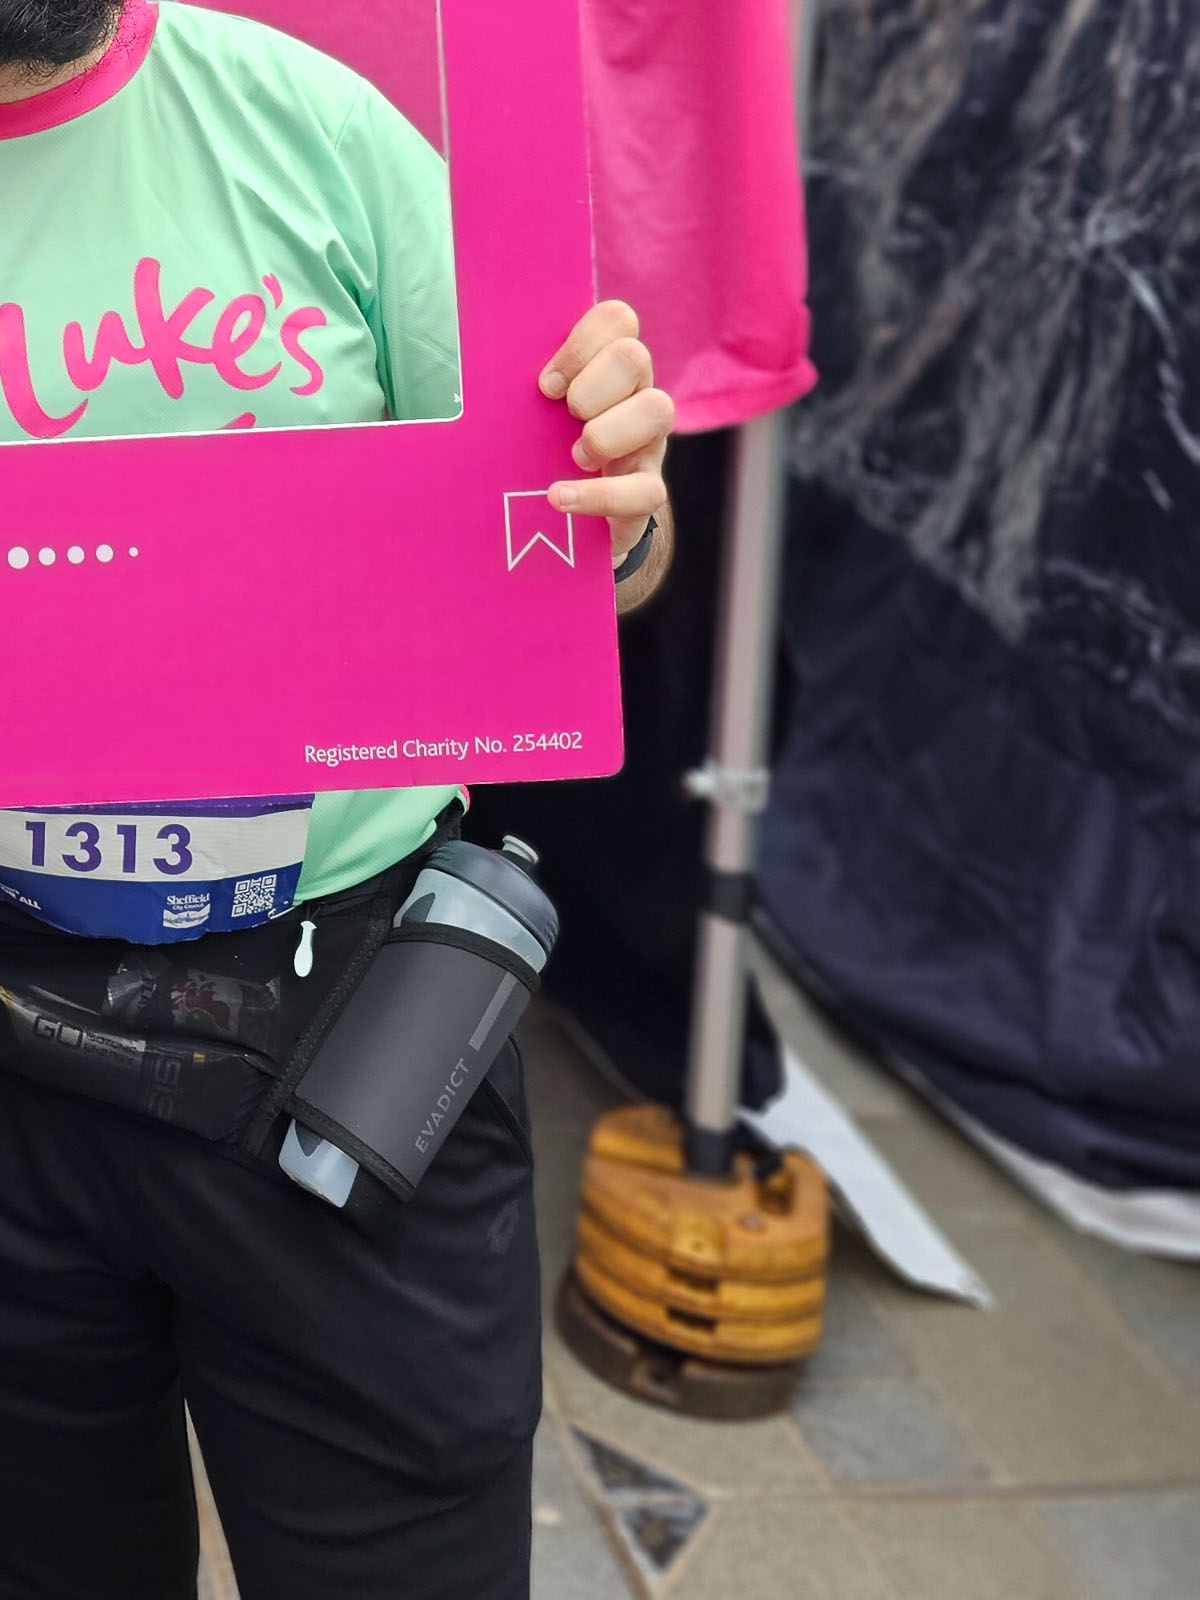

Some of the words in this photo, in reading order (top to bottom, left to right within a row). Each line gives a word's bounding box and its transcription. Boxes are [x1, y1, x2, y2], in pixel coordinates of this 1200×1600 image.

[304, 740, 398, 767] Registered
[402, 737, 469, 761] Charity
[474, 736, 507, 754] No.
[512, 731, 584, 752] 254402
[25, 820, 195, 875] 1313
[166, 892, 210, 906] Sheffield
[414, 1057, 470, 1154] EVADICT
